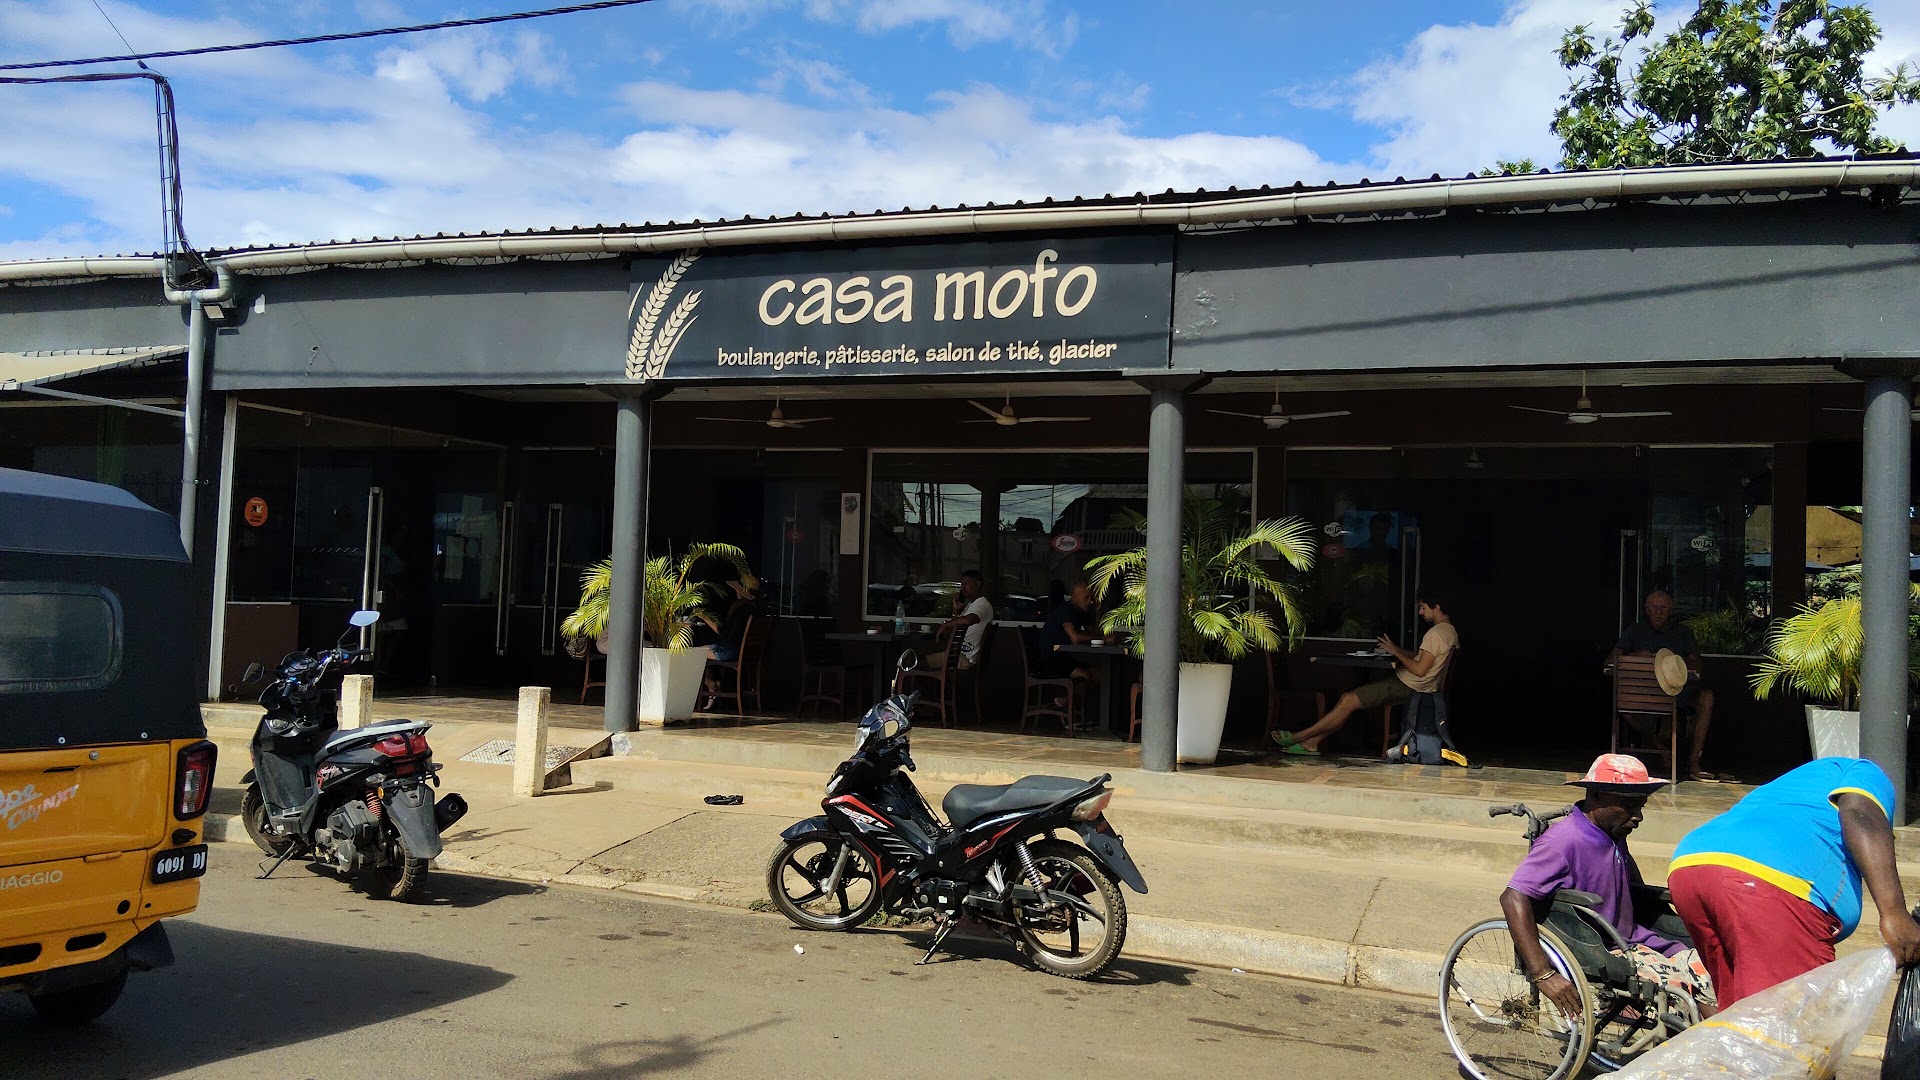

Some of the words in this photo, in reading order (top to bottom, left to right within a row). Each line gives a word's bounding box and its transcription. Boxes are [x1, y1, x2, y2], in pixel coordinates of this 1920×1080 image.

[758, 274, 913, 326] casa
[934, 248, 1099, 322] mofo
[717, 345, 821, 371] boulangerie,
[824, 343, 920, 370] pâtisserie,
[925, 341, 975, 362] salon
[977, 340, 1002, 362] de
[1005, 339, 1044, 364] thé,
[1048, 338, 1118, 366] glacier
[156, 855, 185, 875] 6091
[192, 851, 206, 870] DJ
[0, 870, 63, 890] IAGGIO
